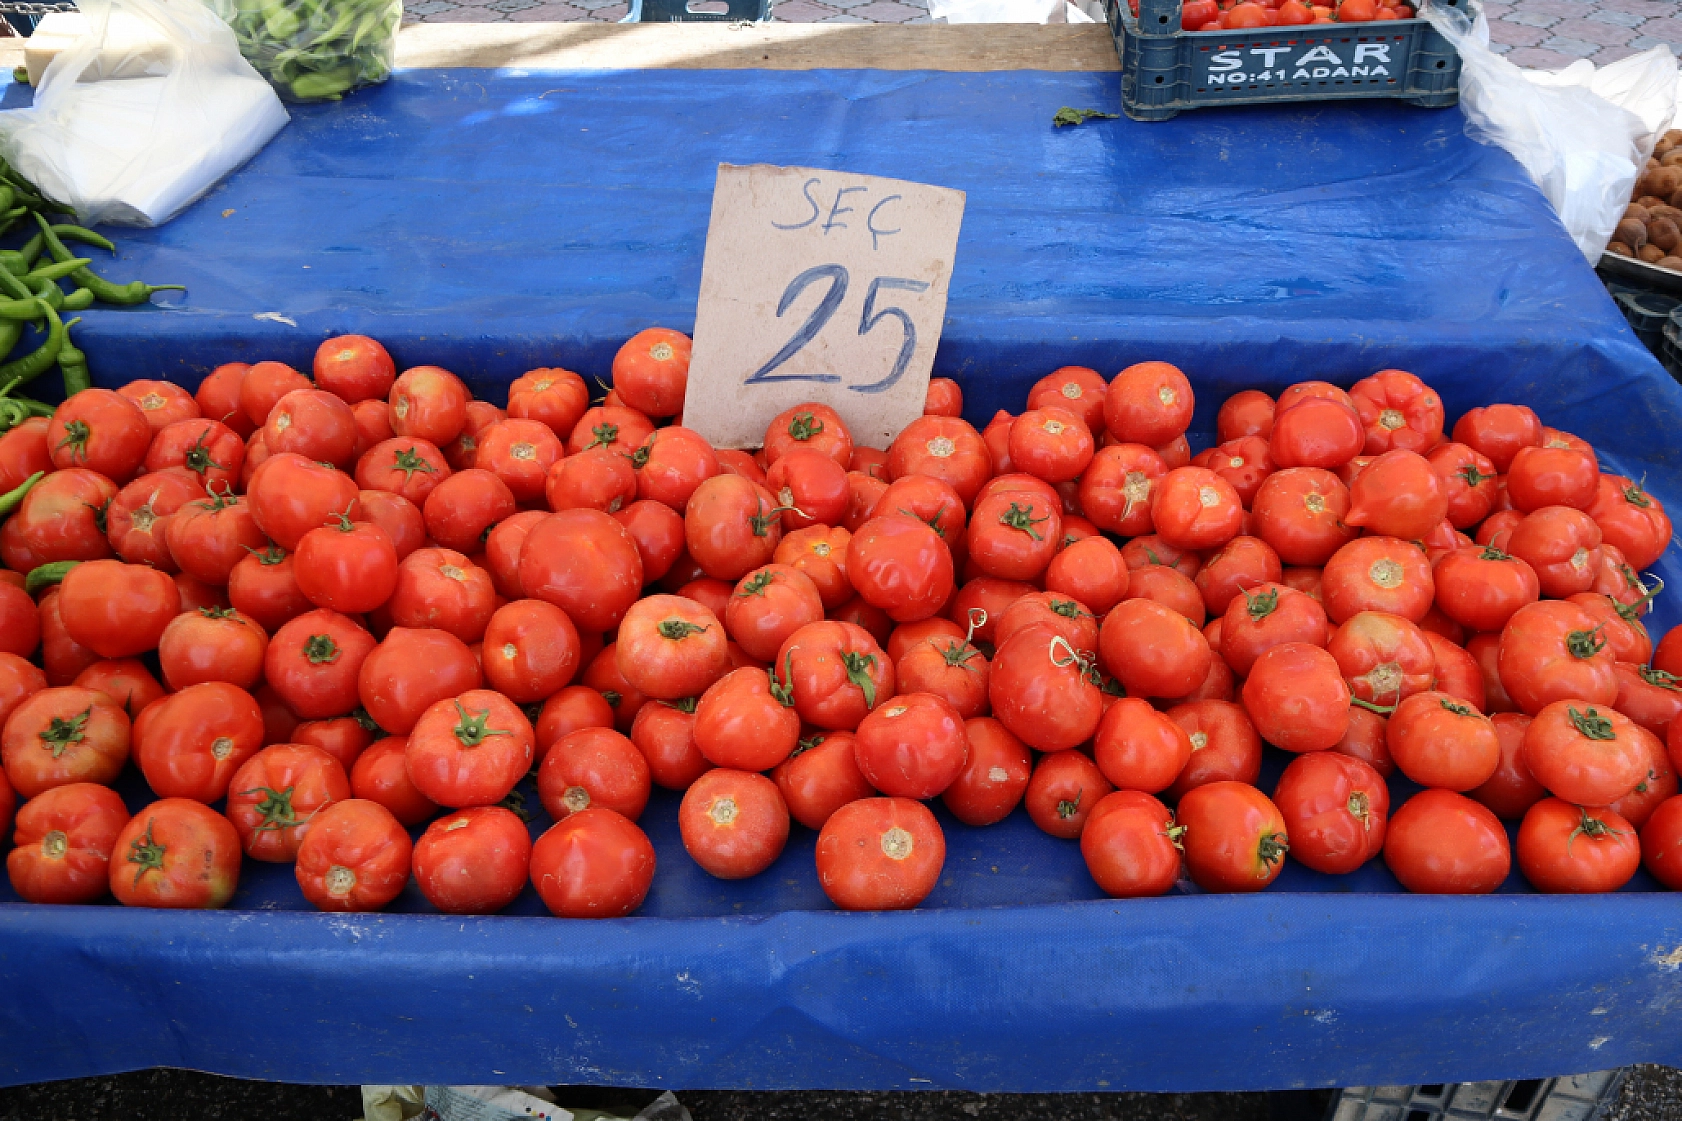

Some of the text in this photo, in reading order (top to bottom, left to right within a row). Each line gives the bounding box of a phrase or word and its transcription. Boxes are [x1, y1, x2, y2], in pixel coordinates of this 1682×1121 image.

[1206, 65, 1389, 85] NO:41 ADANA
[1207, 43, 1392, 72] STAR
[771, 178, 902, 250] SEÇ
[744, 263, 930, 392] 25
